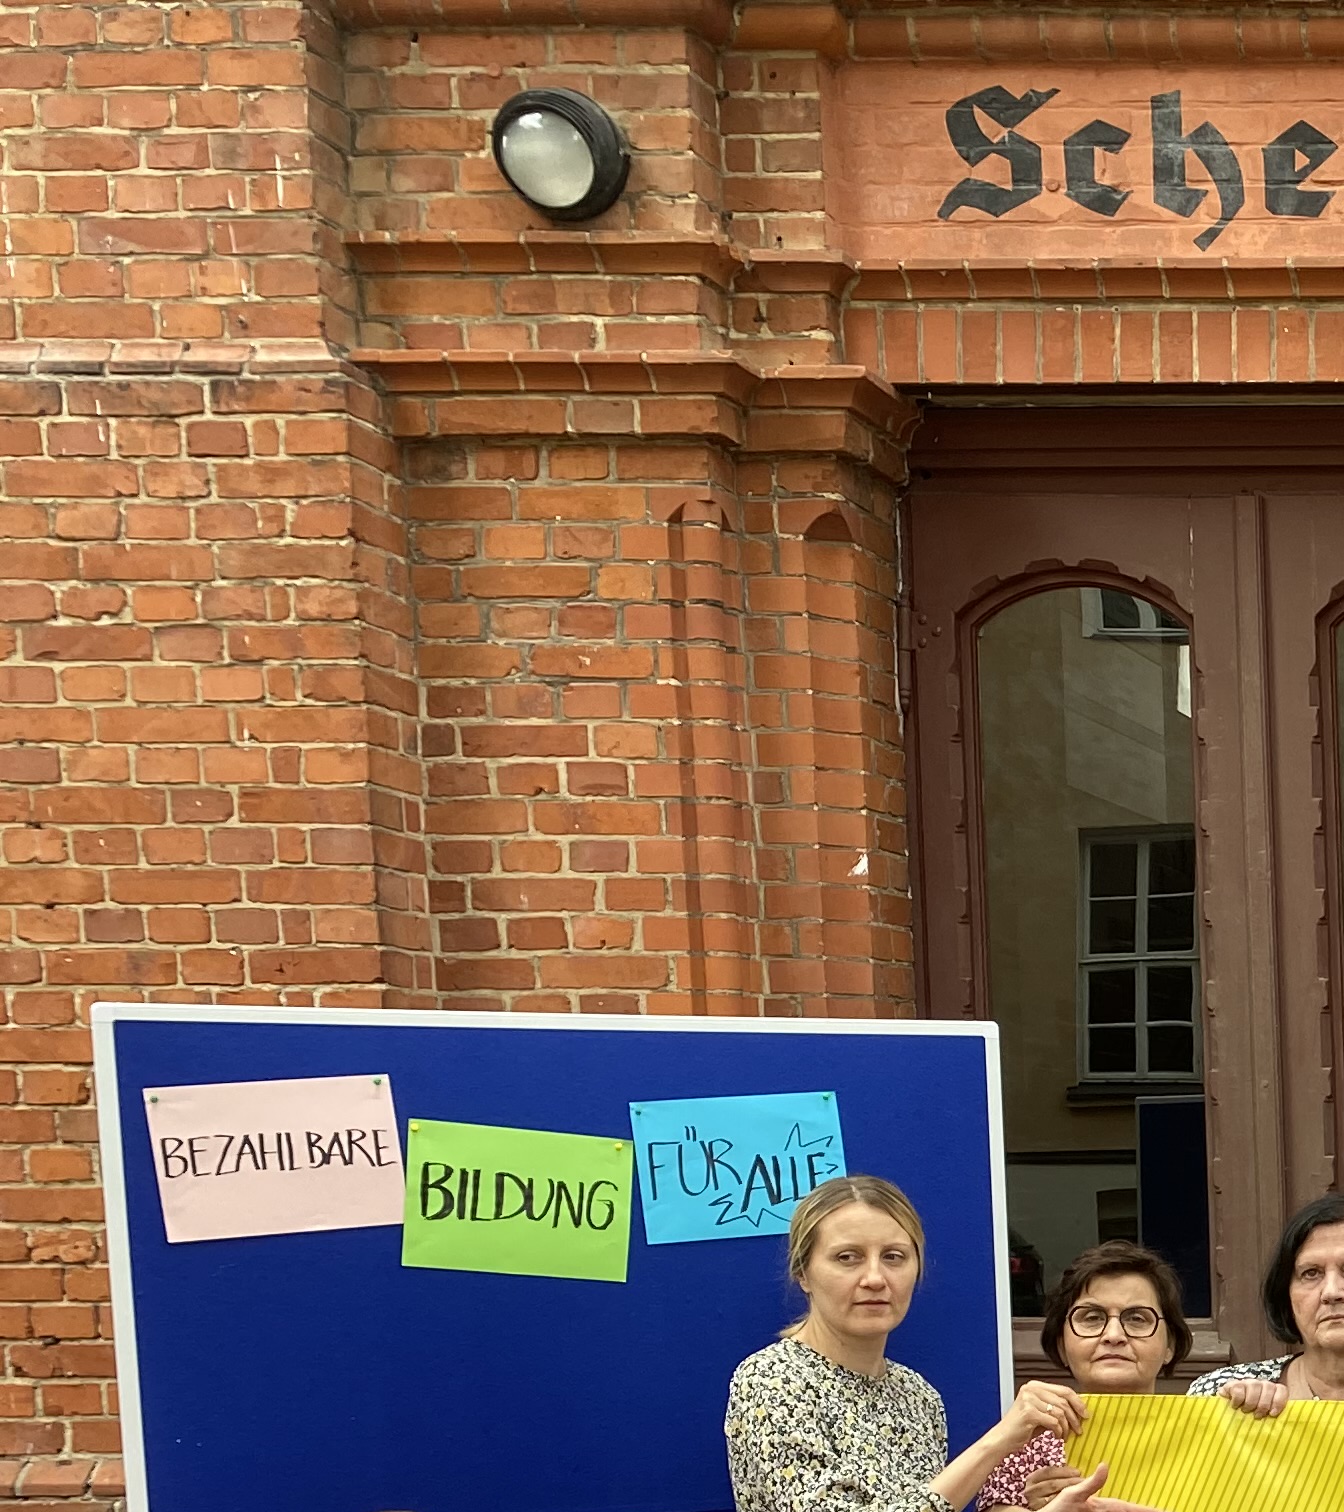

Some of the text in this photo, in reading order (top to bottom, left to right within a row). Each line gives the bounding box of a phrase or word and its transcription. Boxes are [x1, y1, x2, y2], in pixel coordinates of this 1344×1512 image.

[160, 1128, 398, 1179] BEZAHLBARE
[646, 1126, 742, 1201] FÜR
[419, 1162, 617, 1231] BILDUNG
